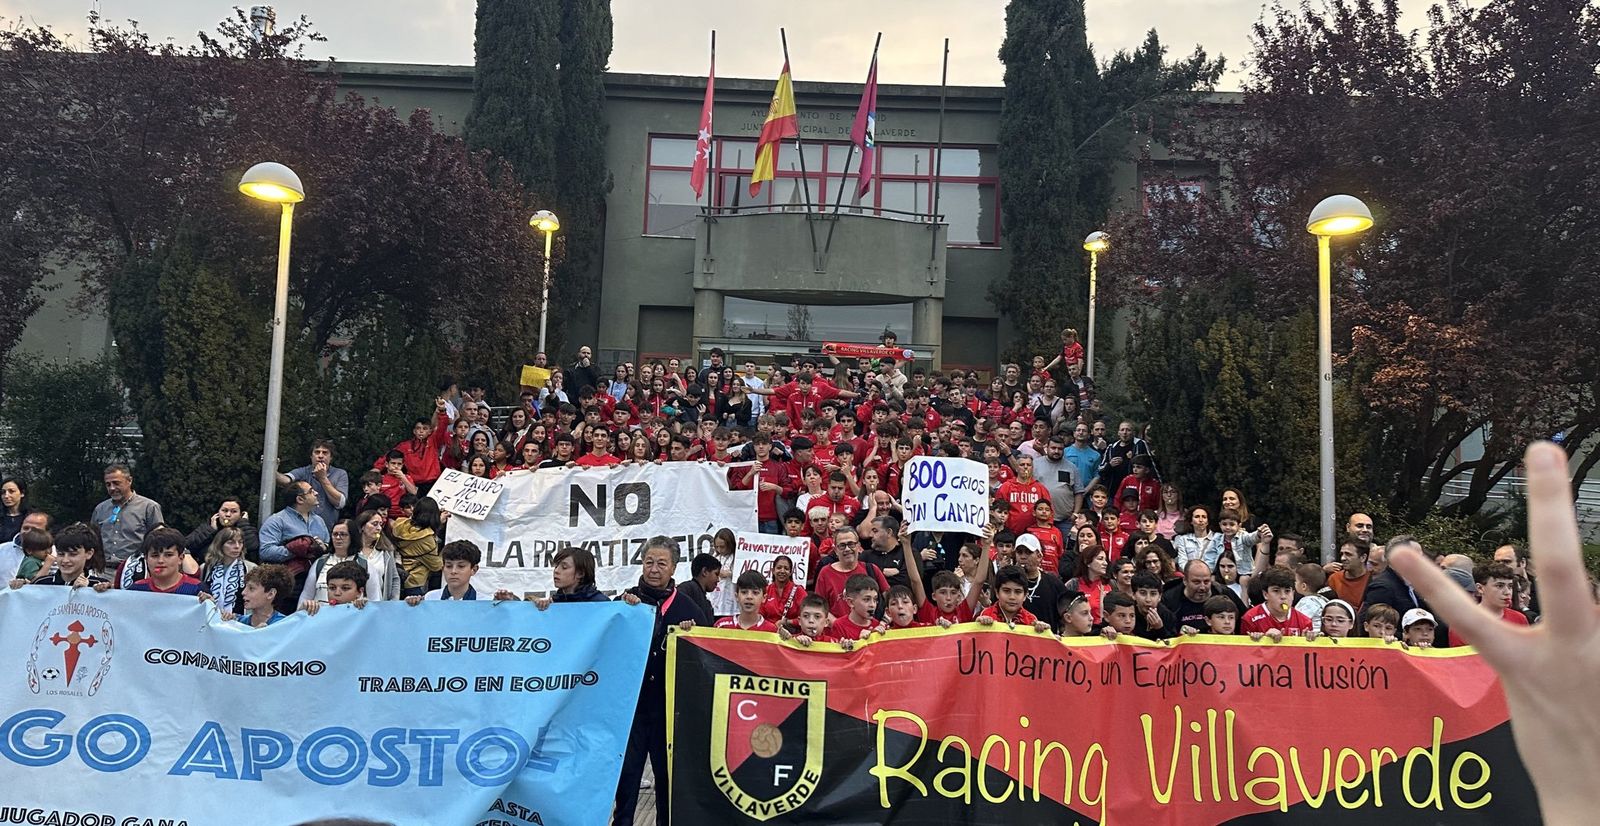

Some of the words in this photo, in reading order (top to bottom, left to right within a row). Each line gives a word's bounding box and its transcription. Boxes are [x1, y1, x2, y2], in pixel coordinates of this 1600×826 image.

[741, 123, 764, 132] JUNT
[829, 112, 841, 121] DE
[444, 471, 461, 483] EL
[463, 476, 504, 494] CAMPO
[908, 460, 947, 491] 800
[950, 475, 986, 495] CRIOS
[433, 489, 451, 506] SE
[453, 499, 490, 516] VENDE
[454, 487, 478, 500] NO
[569, 481, 651, 528] NO
[904, 499, 927, 524] SIN
[934, 493, 986, 528] CAMPO
[486, 540, 525, 568] LA
[740, 559, 759, 574] NO
[57, 603, 85, 616] SANTIAGO
[85, 604, 109, 620] APOSTOL
[427, 636, 552, 653] ESFUERZO
[144, 648, 327, 678] COMPAÑERISMO
[956, 638, 994, 676] Un
[1005, 639, 1093, 693] barrio,
[1100, 657, 1122, 685] un
[1133, 652, 1227, 700] Equipo,
[1239, 661, 1292, 689] una
[1304, 652, 1390, 691] Ilusión
[358, 676, 468, 693] TRABAJO
[474, 676, 504, 692] EN
[510, 670, 600, 692] EQUIPO
[730, 676, 811, 697] RACING
[736, 700, 758, 721] C
[773, 765, 793, 786] F
[868, 708, 1108, 826] Racing
[1139, 704, 1493, 813] Villaverde
[712, 766, 820, 817] VILLAVERDE
[0, 807, 116, 826] JUGADOR
